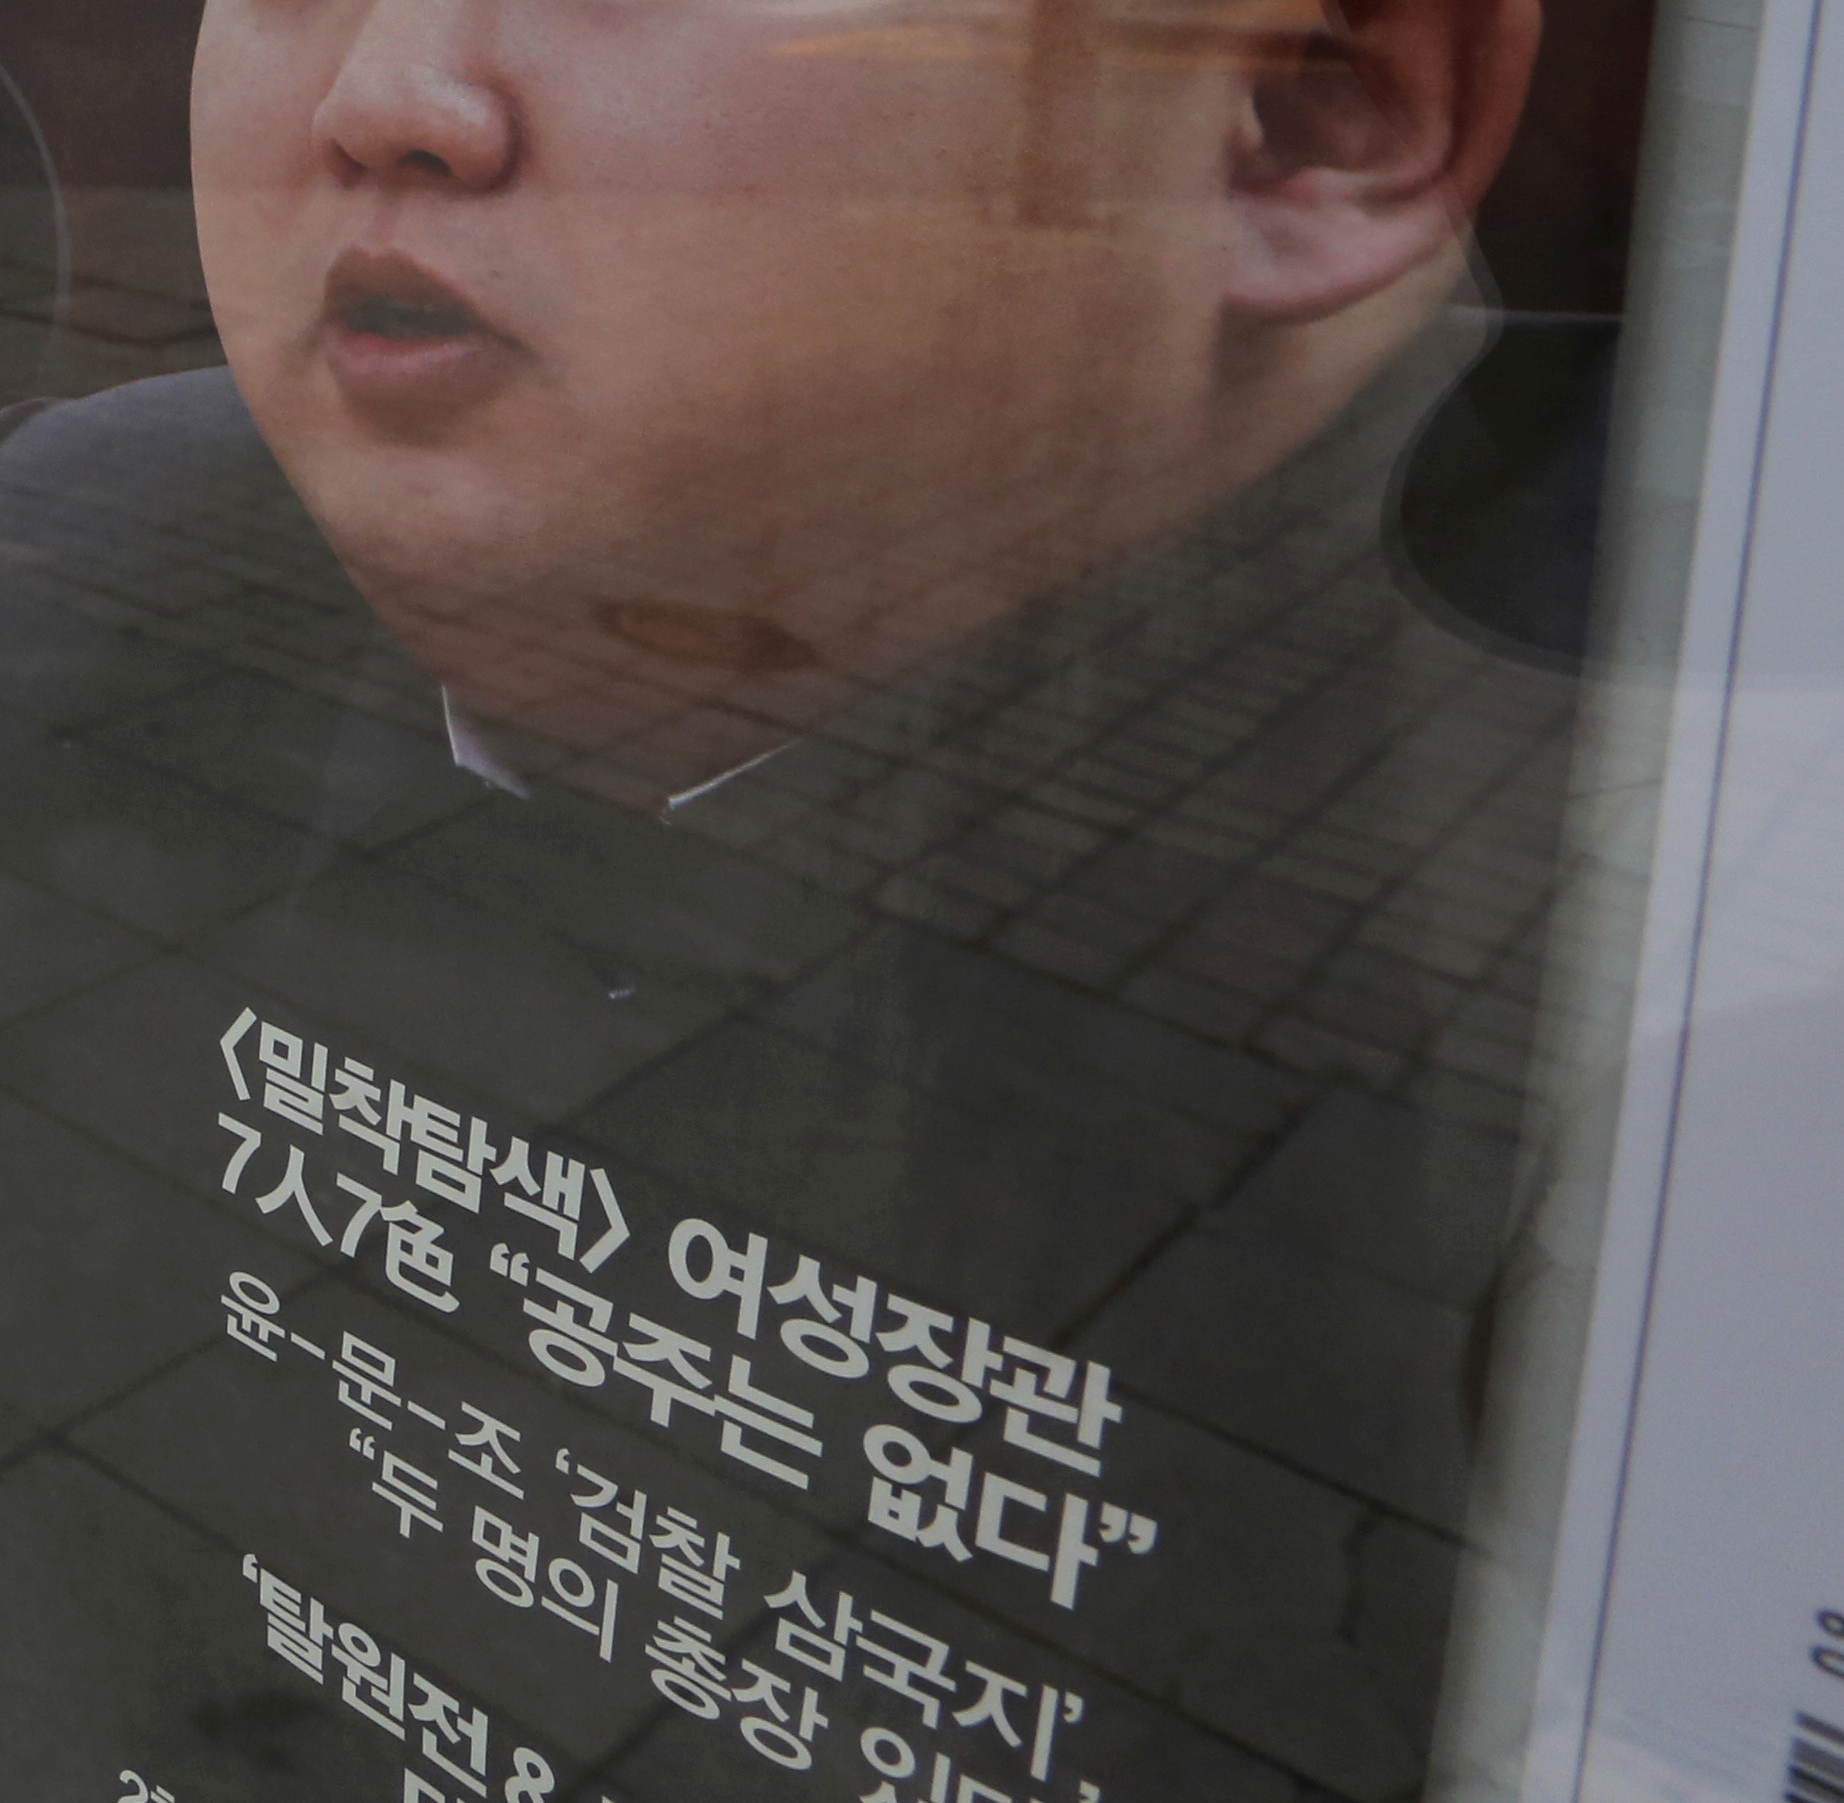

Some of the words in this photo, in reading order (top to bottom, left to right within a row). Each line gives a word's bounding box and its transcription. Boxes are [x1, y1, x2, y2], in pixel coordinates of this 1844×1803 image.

[218, 1112, 461, 1314] 7人7色
[489, 1243, 824, 1490] “공주는
[861, 1421, 1157, 1609] 없다”
[667, 1217, 1124, 1476] 여성장관
[242, 1553, 489, 1798] ‘탈원전
[349, 1426, 445, 1539] “두
[470, 1506, 619, 1662] 명의
[644, 1615, 829, 1771] 총장
[555, 1447, 741, 1621] ‘검찰
[763, 1570, 1085, 1782] 삼국지’
